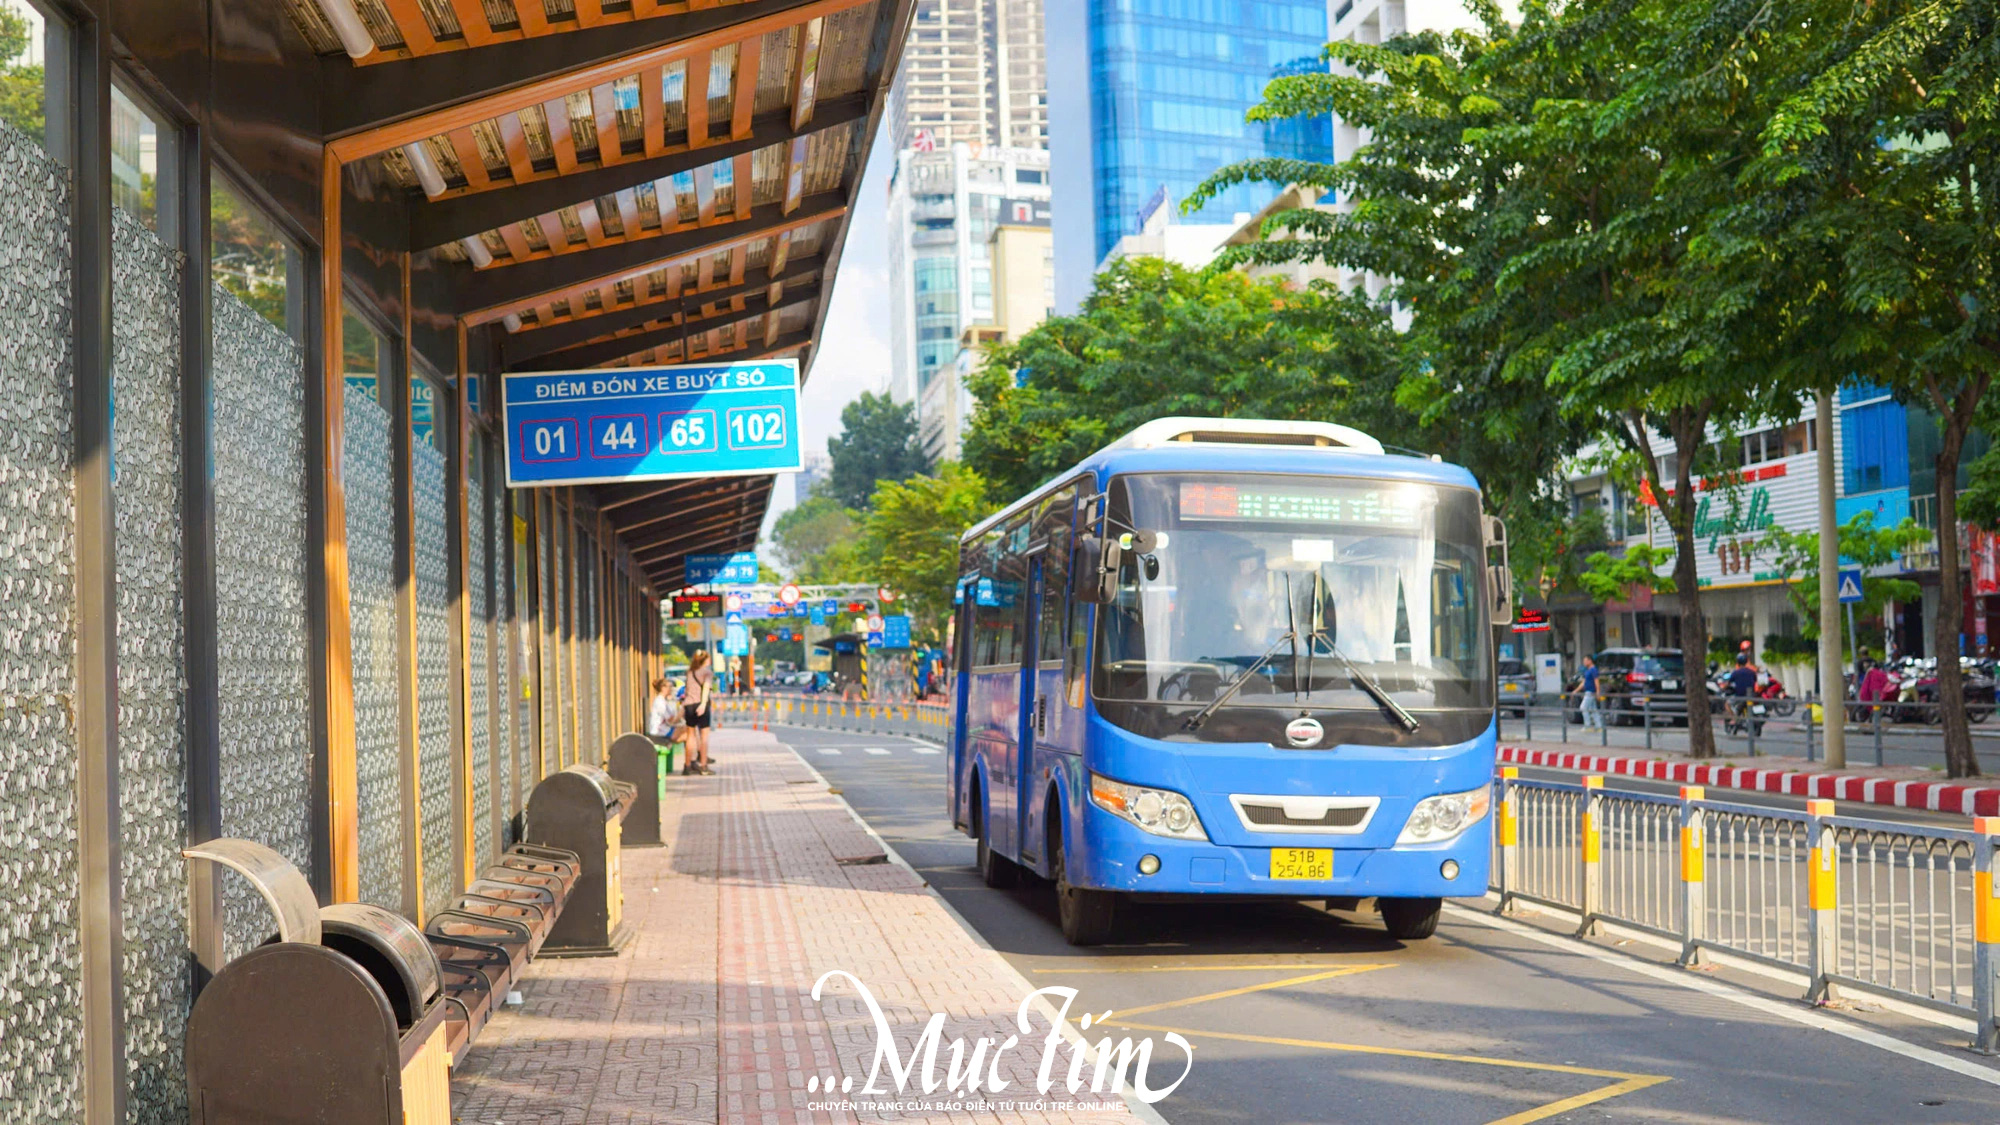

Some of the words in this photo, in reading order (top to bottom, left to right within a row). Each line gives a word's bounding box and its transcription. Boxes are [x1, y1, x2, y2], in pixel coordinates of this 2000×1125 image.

[592, 376, 637, 395] ĐÓN
[643, 376, 670, 392] XE
[676, 370, 731, 389] BUÝT
[534, 425, 566, 456] 01
[602, 421, 637, 450] 44
[670, 417, 706, 447] 65
[730, 412, 783, 444] 102
[1288, 850, 1315, 863] 51B
[1277, 864, 1325, 878] 254.86
